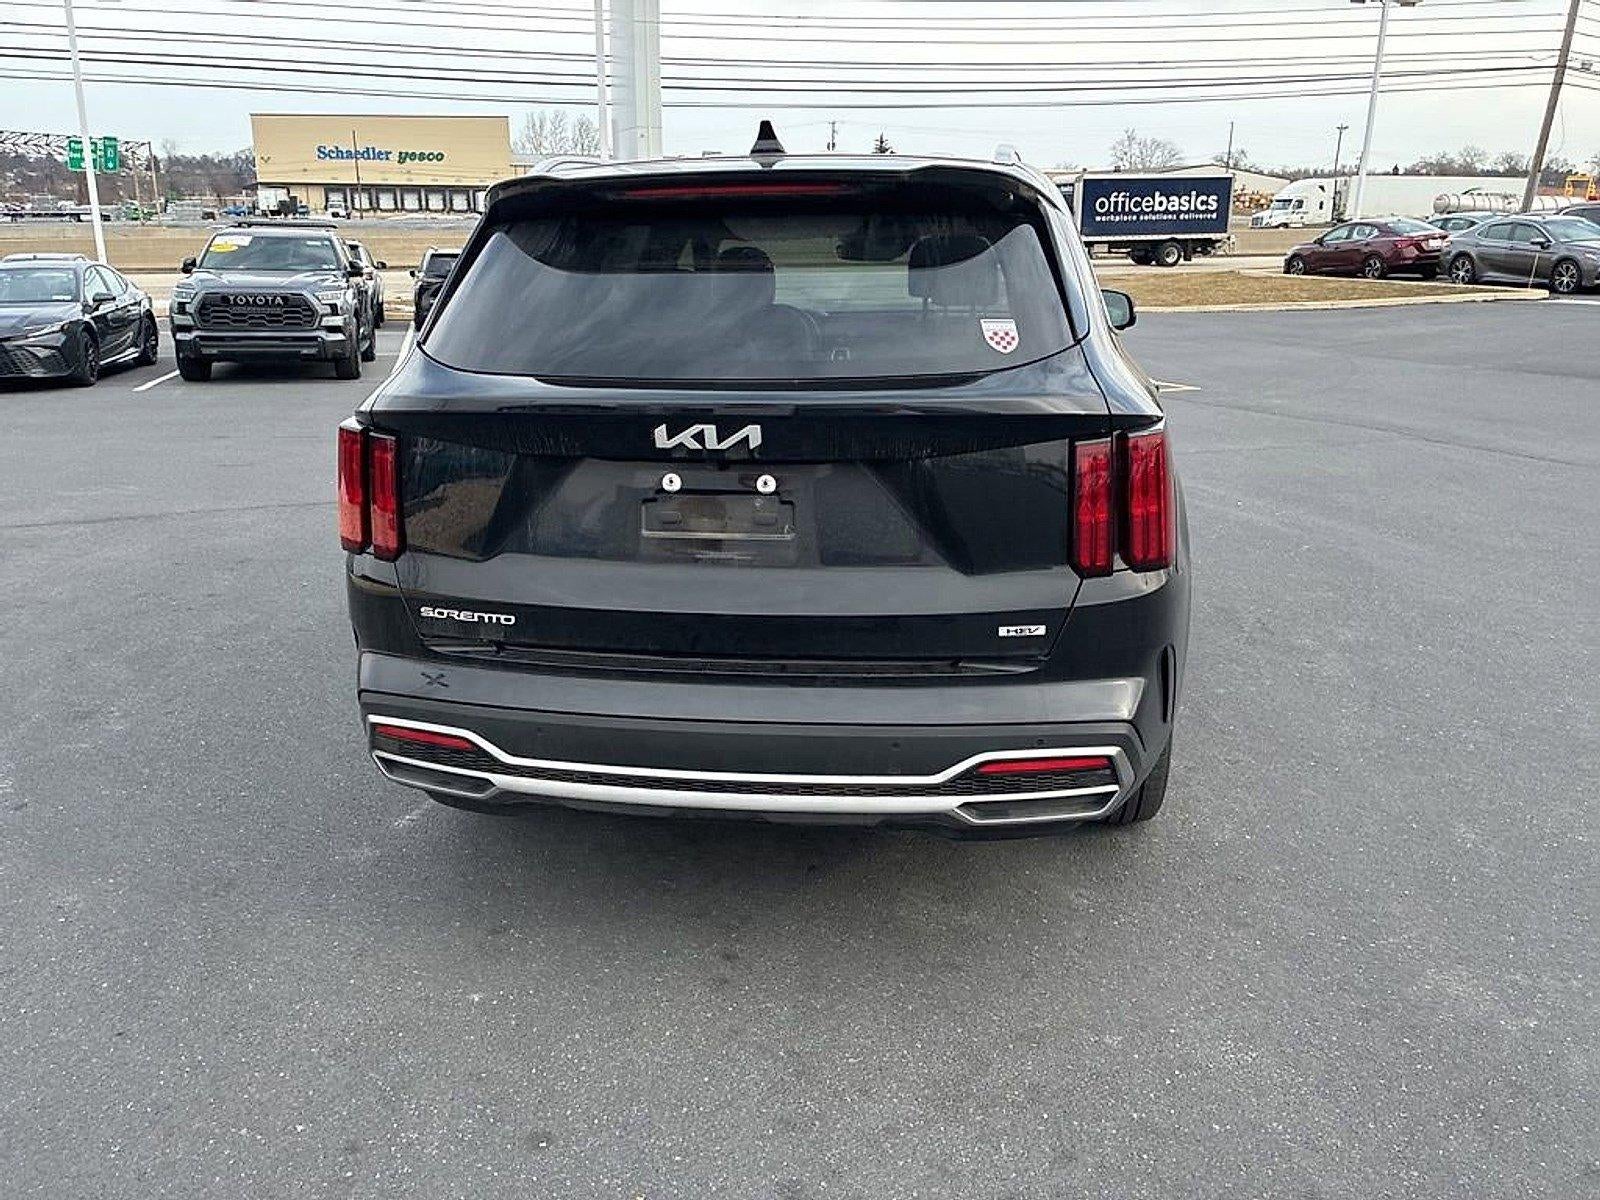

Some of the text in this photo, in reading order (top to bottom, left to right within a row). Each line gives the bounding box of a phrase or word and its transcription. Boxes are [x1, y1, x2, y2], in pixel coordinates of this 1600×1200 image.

[317, 145, 393, 161] Schaedler
[1095, 190, 1218, 213] officebasics
[1140, 212, 1177, 221] solutions
[1179, 212, 1217, 220] delivered
[228, 295, 284, 306] TOYOTA
[654, 423, 762, 449] KIA
[420, 606, 516, 625] SORENTO
